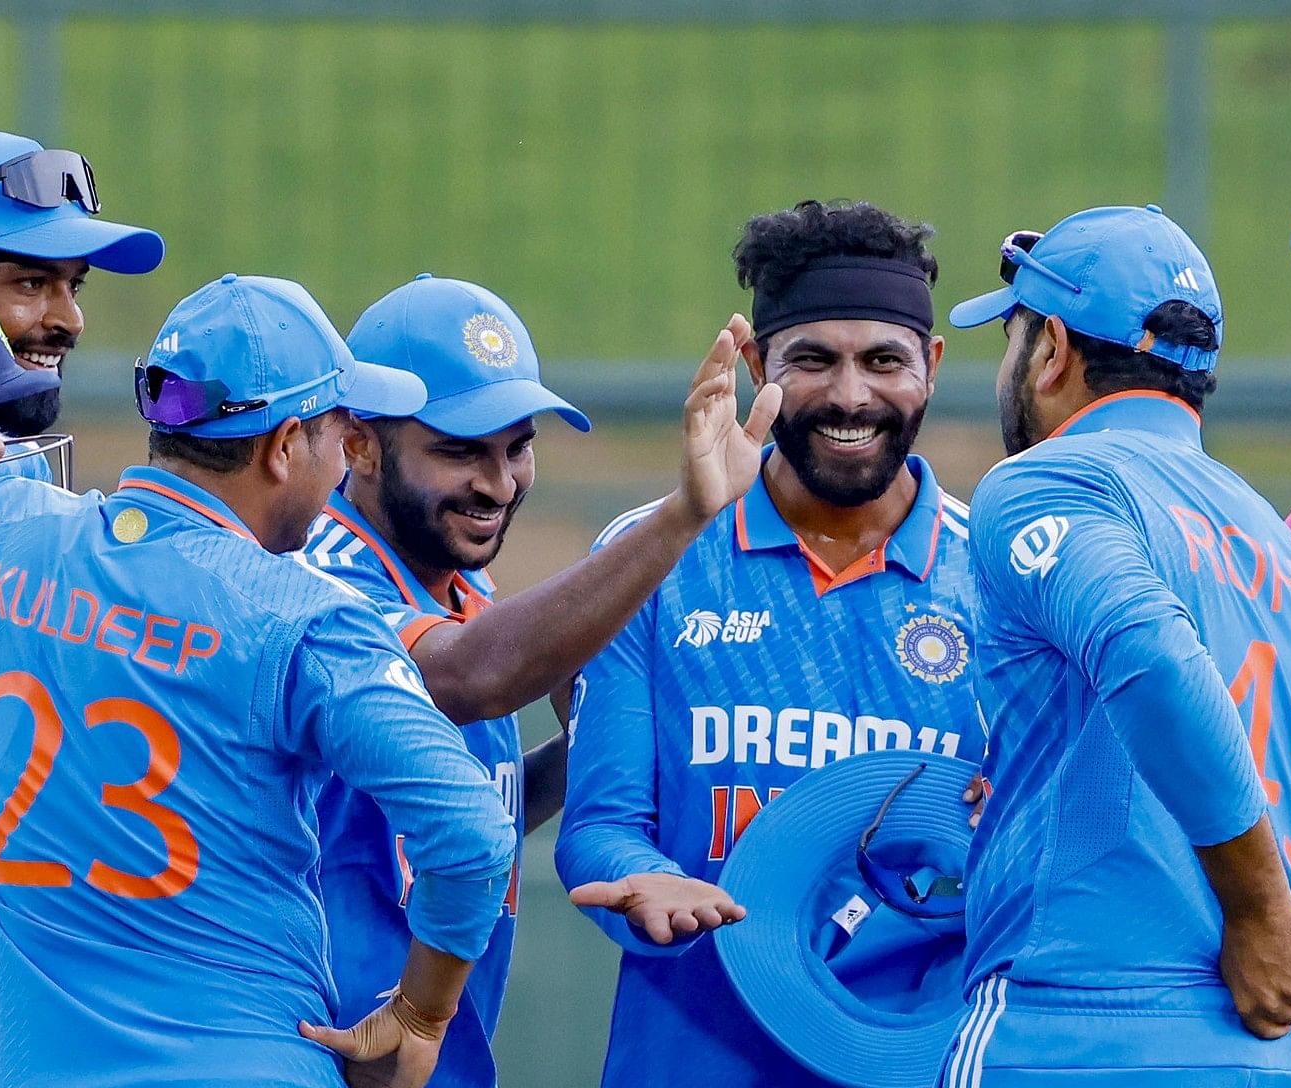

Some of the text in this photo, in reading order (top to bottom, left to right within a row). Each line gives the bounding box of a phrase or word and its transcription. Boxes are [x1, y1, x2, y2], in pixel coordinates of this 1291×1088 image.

[300, 394, 317, 413] 217
[724, 610, 771, 627] ASIA
[721, 625, 762, 643] CUP
[690, 704, 961, 769] DREAM11
